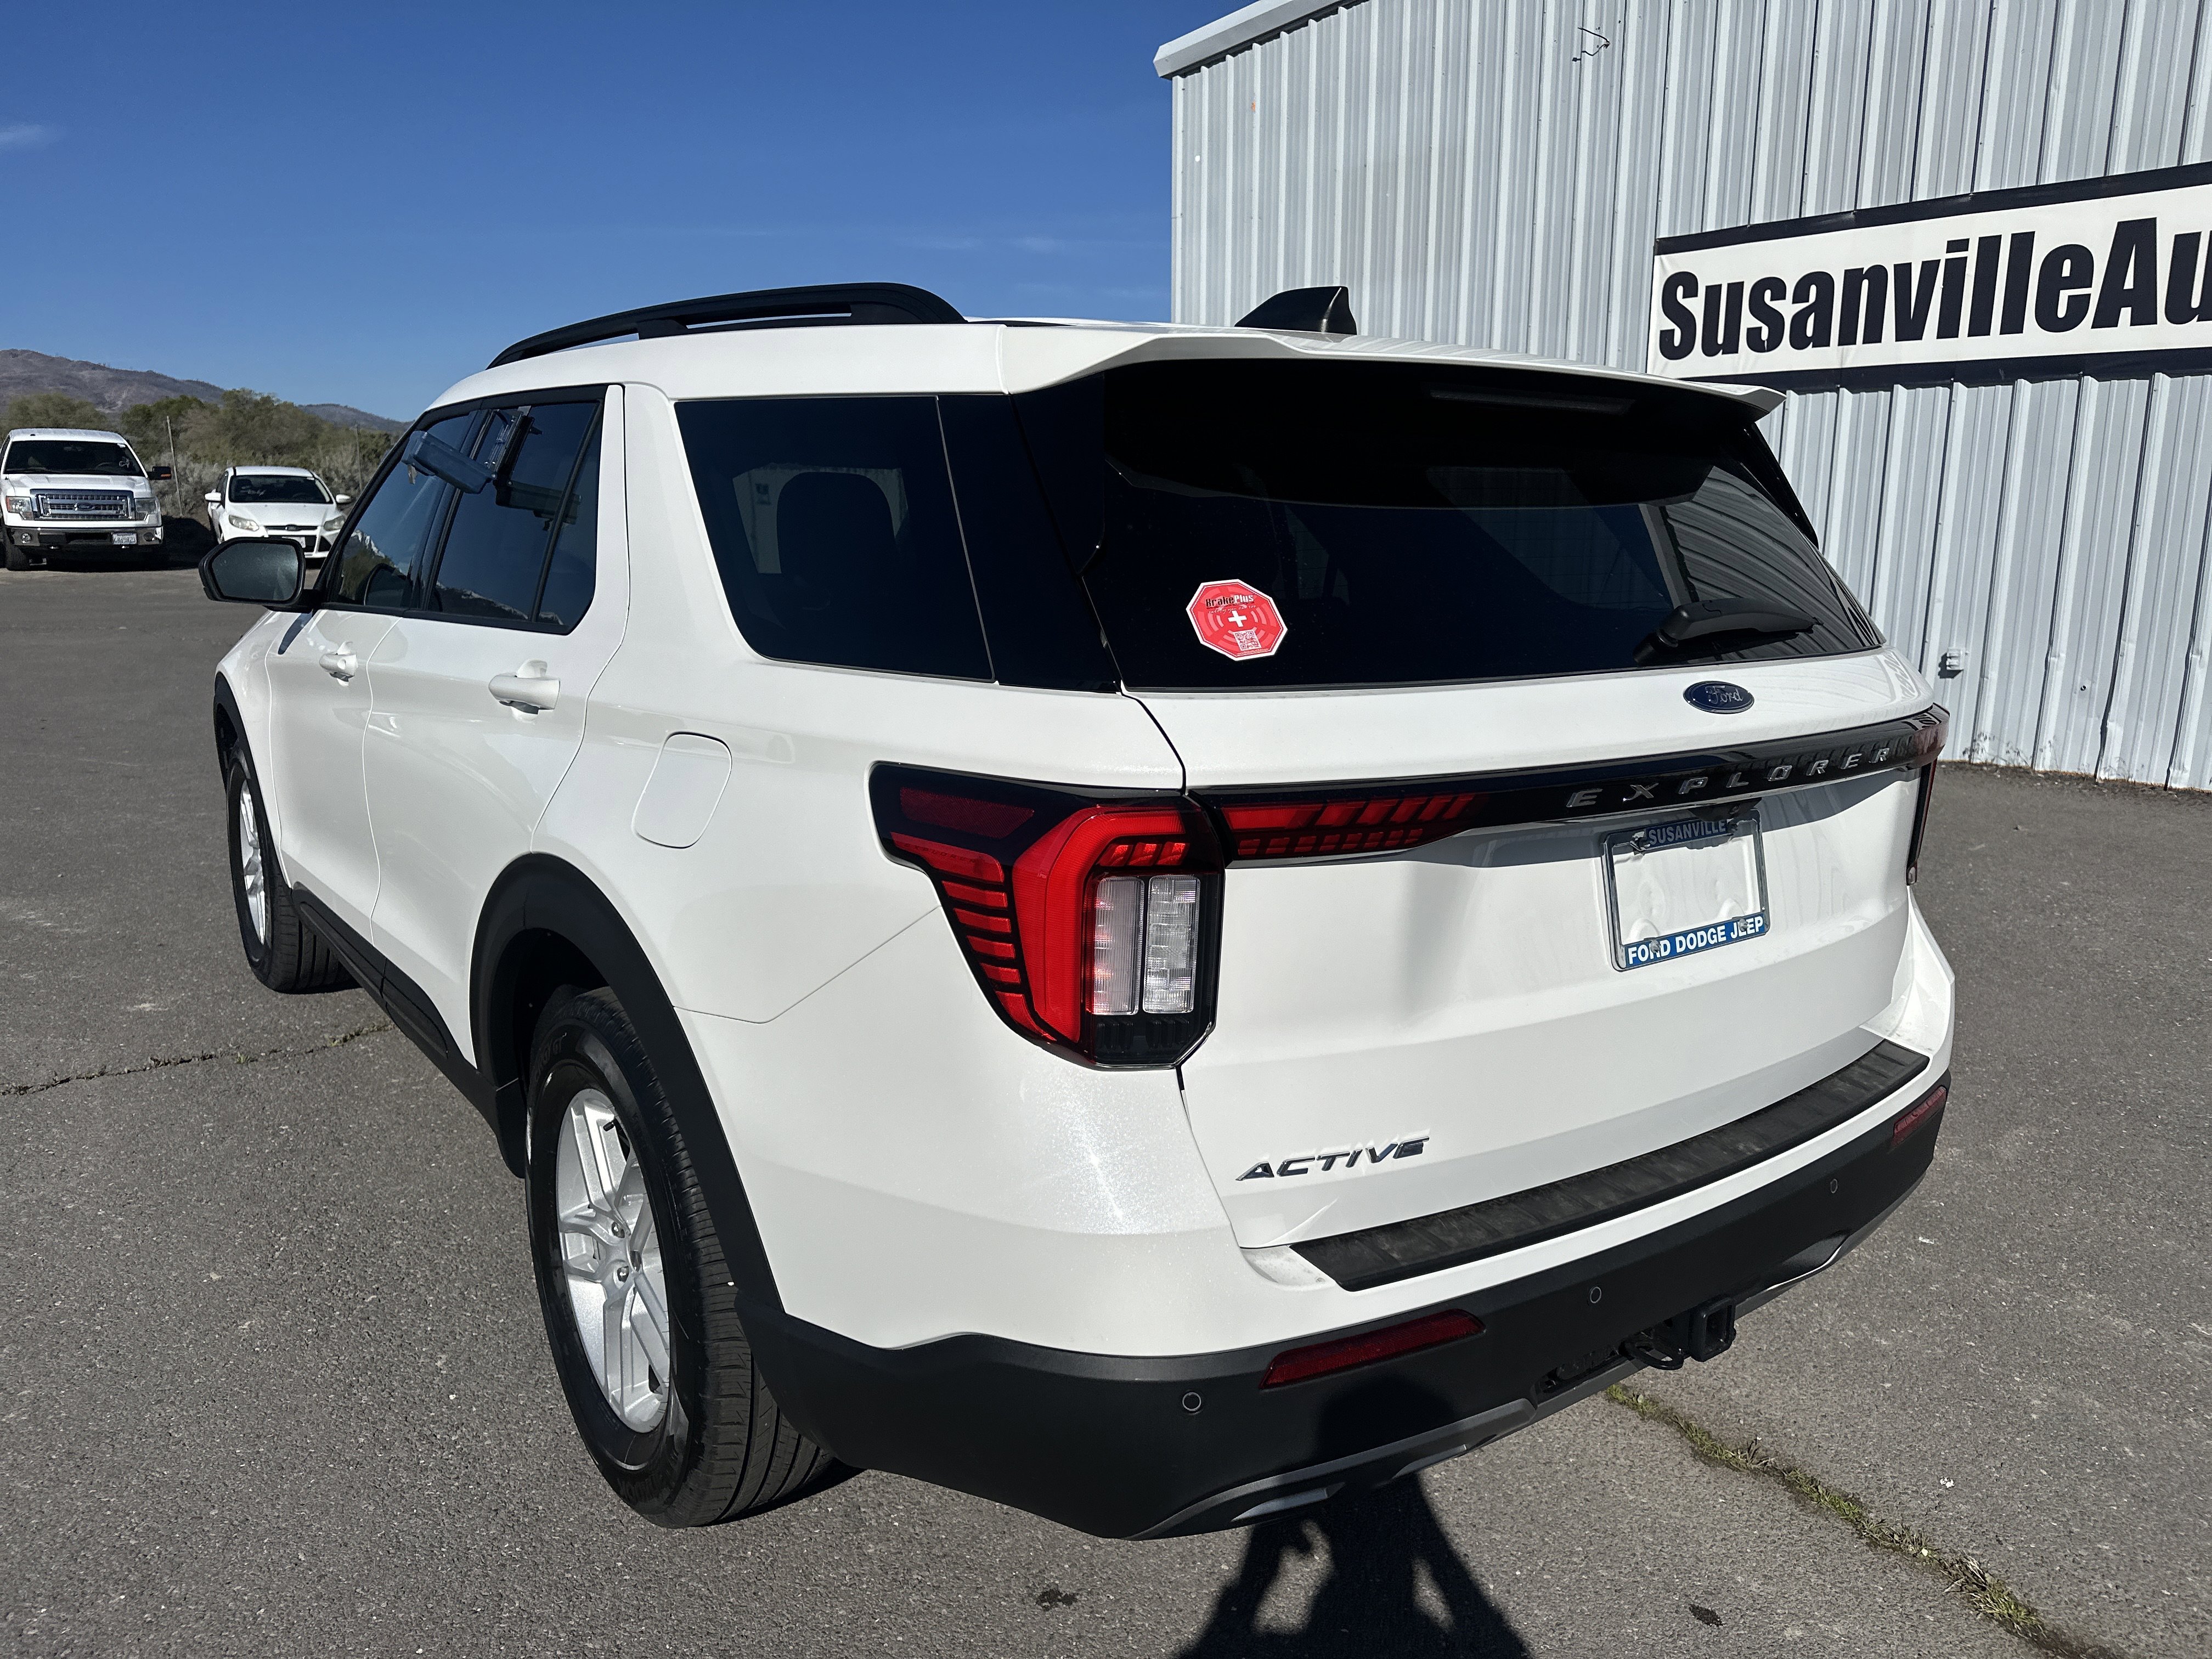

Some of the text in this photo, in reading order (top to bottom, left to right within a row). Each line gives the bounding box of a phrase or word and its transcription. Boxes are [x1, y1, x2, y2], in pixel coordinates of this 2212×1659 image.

[1658, 217, 2212, 360] SusanvilleAu
[1705, 685, 1743, 704] Ford
[1566, 747, 1890, 808] EXPLORER
[1649, 819, 1726, 845] SUSANVILLE
[1675, 925, 1726, 953] DODGE
[1235, 1136, 1430, 1181] ACTIVE
